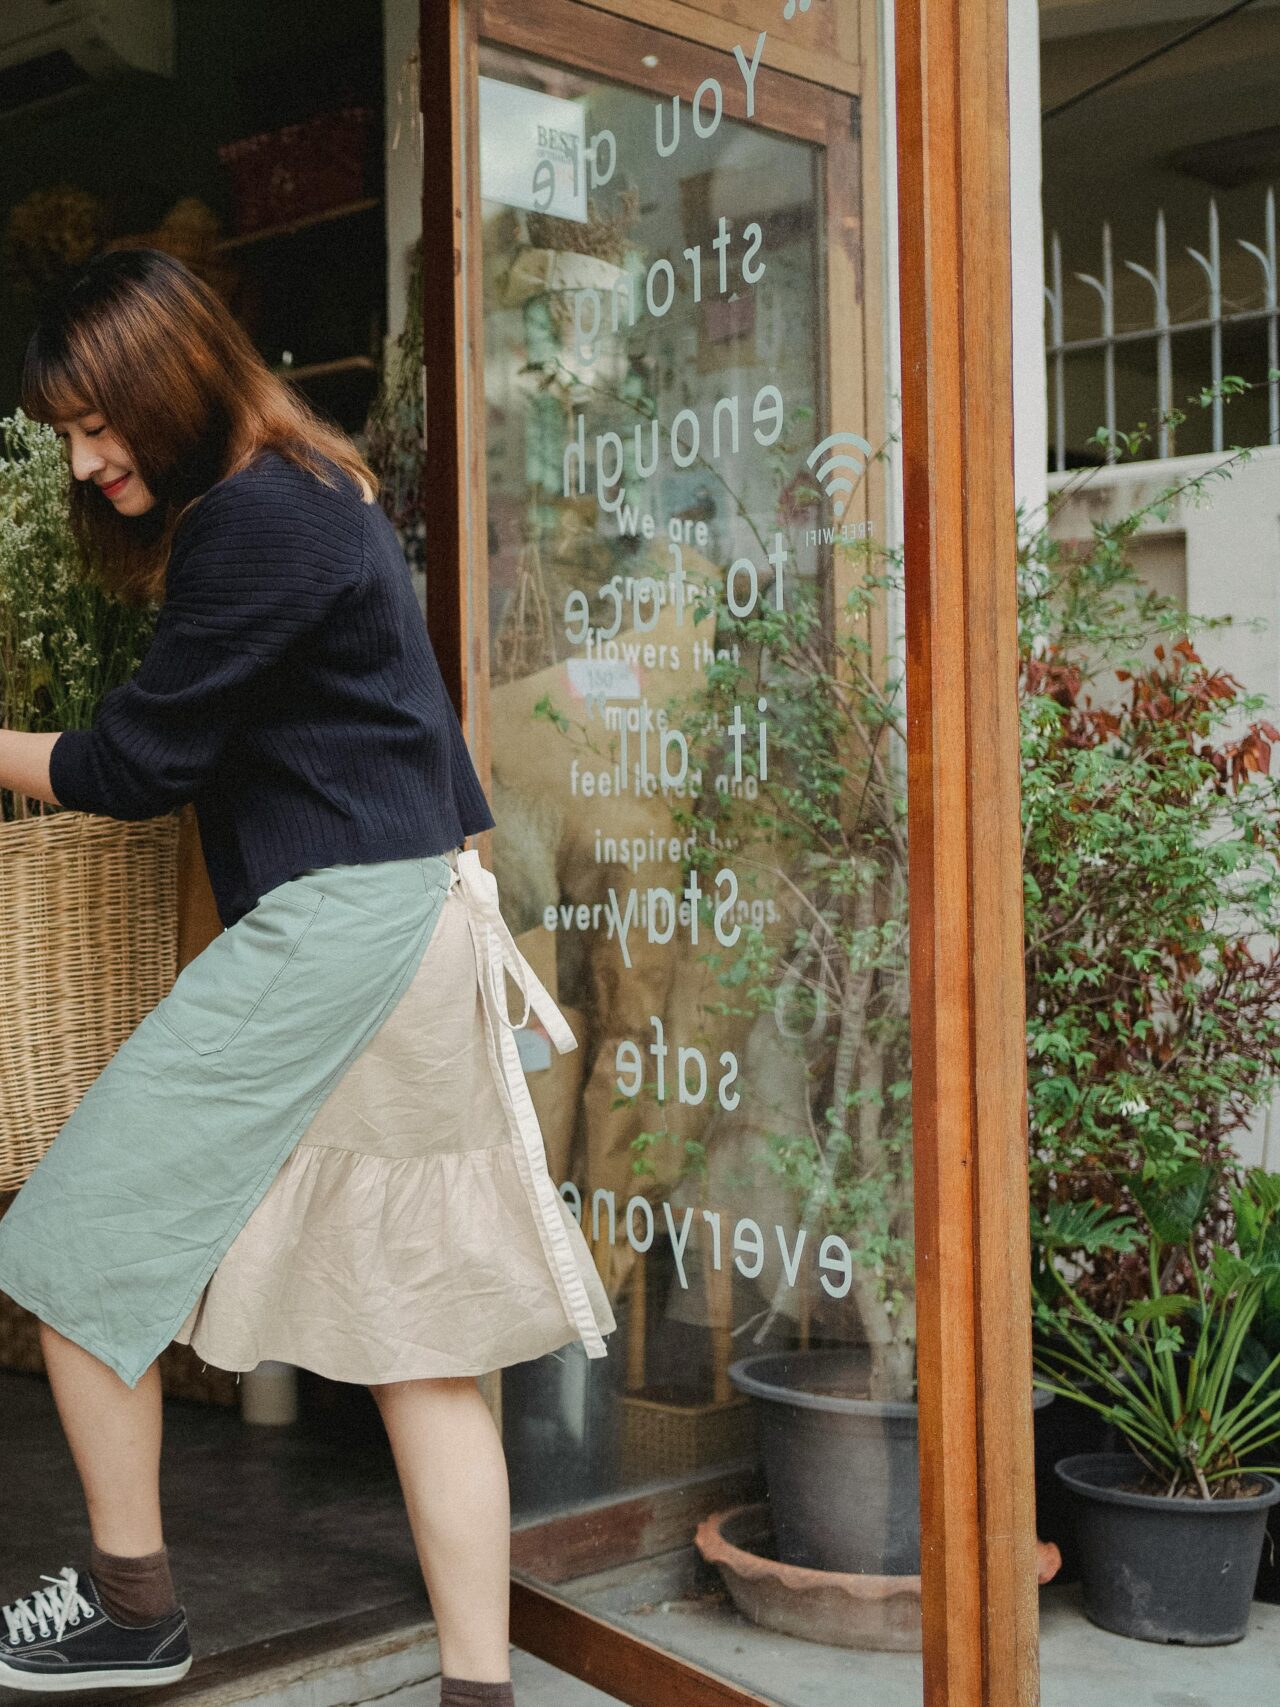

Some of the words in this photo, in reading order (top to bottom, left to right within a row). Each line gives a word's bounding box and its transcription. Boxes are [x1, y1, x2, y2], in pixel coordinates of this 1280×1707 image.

[616, 504, 655, 540] We
[669, 517, 709, 547] are
[586, 627, 680, 671] flowers
[605, 698, 668, 733] make
[571, 760, 620, 798] feel
[595, 828, 697, 875] inspired
[543, 903, 618, 941] every
[633, 892, 695, 929] lite
